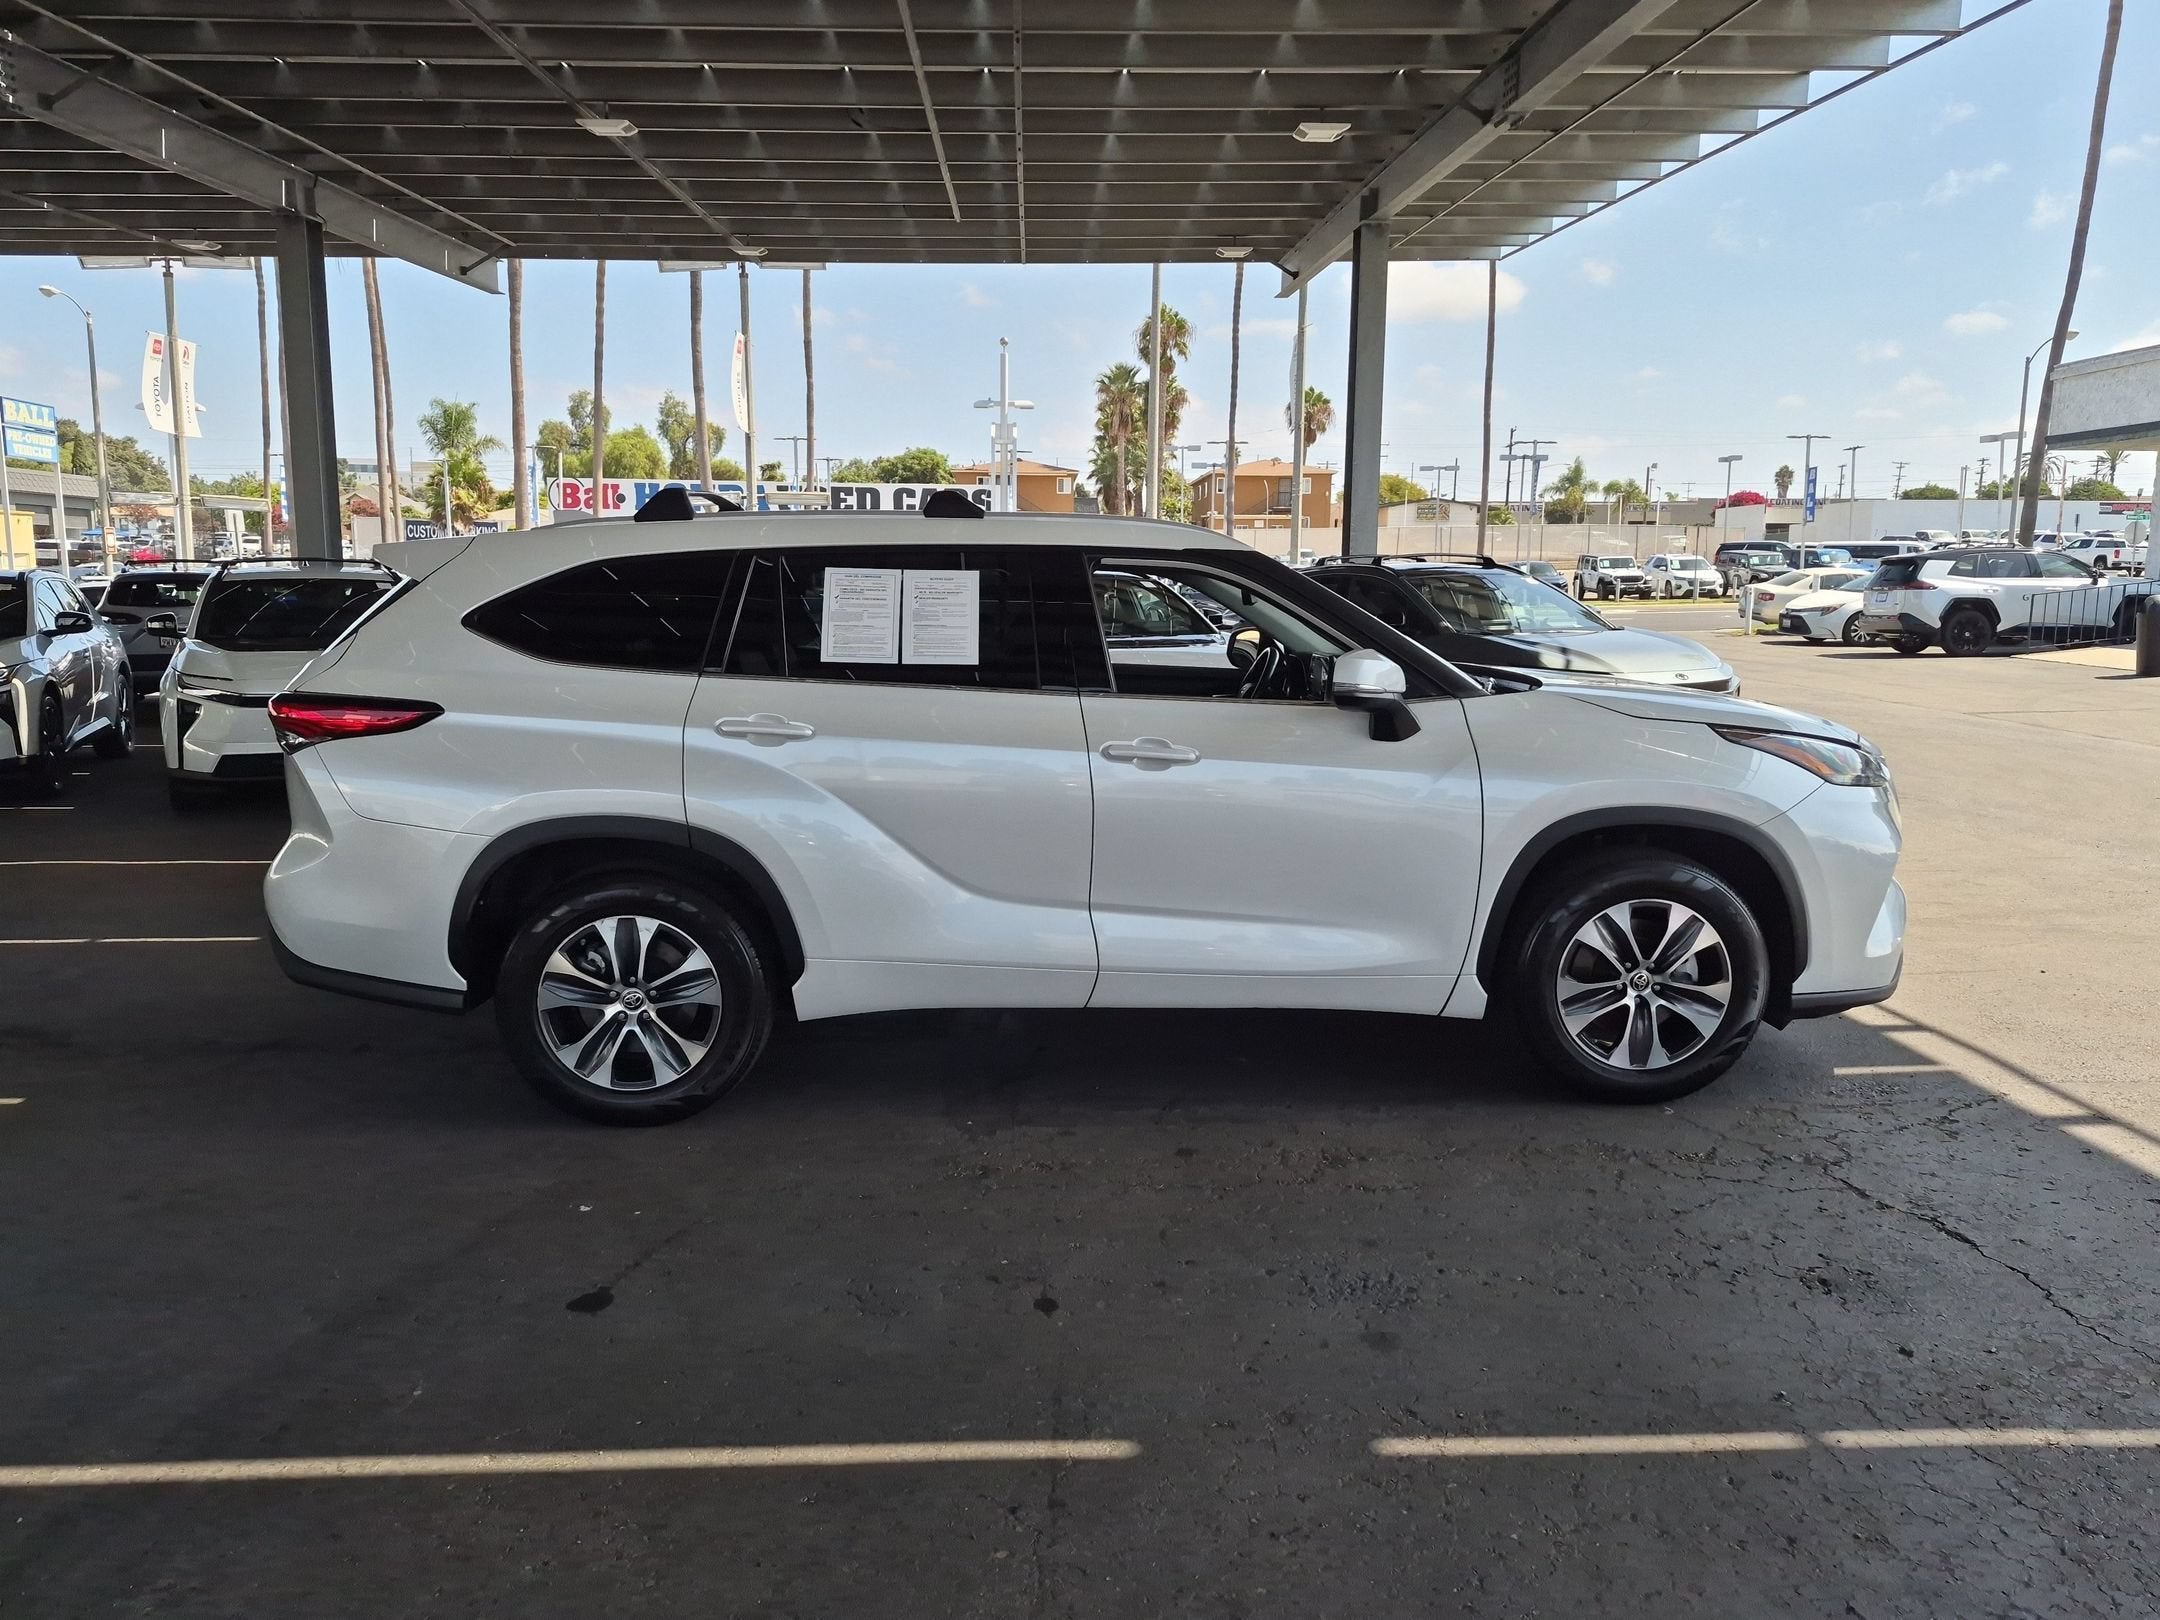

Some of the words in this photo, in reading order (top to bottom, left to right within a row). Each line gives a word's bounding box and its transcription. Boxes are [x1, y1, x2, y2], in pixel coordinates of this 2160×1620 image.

[4, 399, 53, 428] BALL
[153, 376, 162, 417] TOYOTA
[557, 482, 621, 509] Ball
[1806, 469, 1816, 521] BALL
